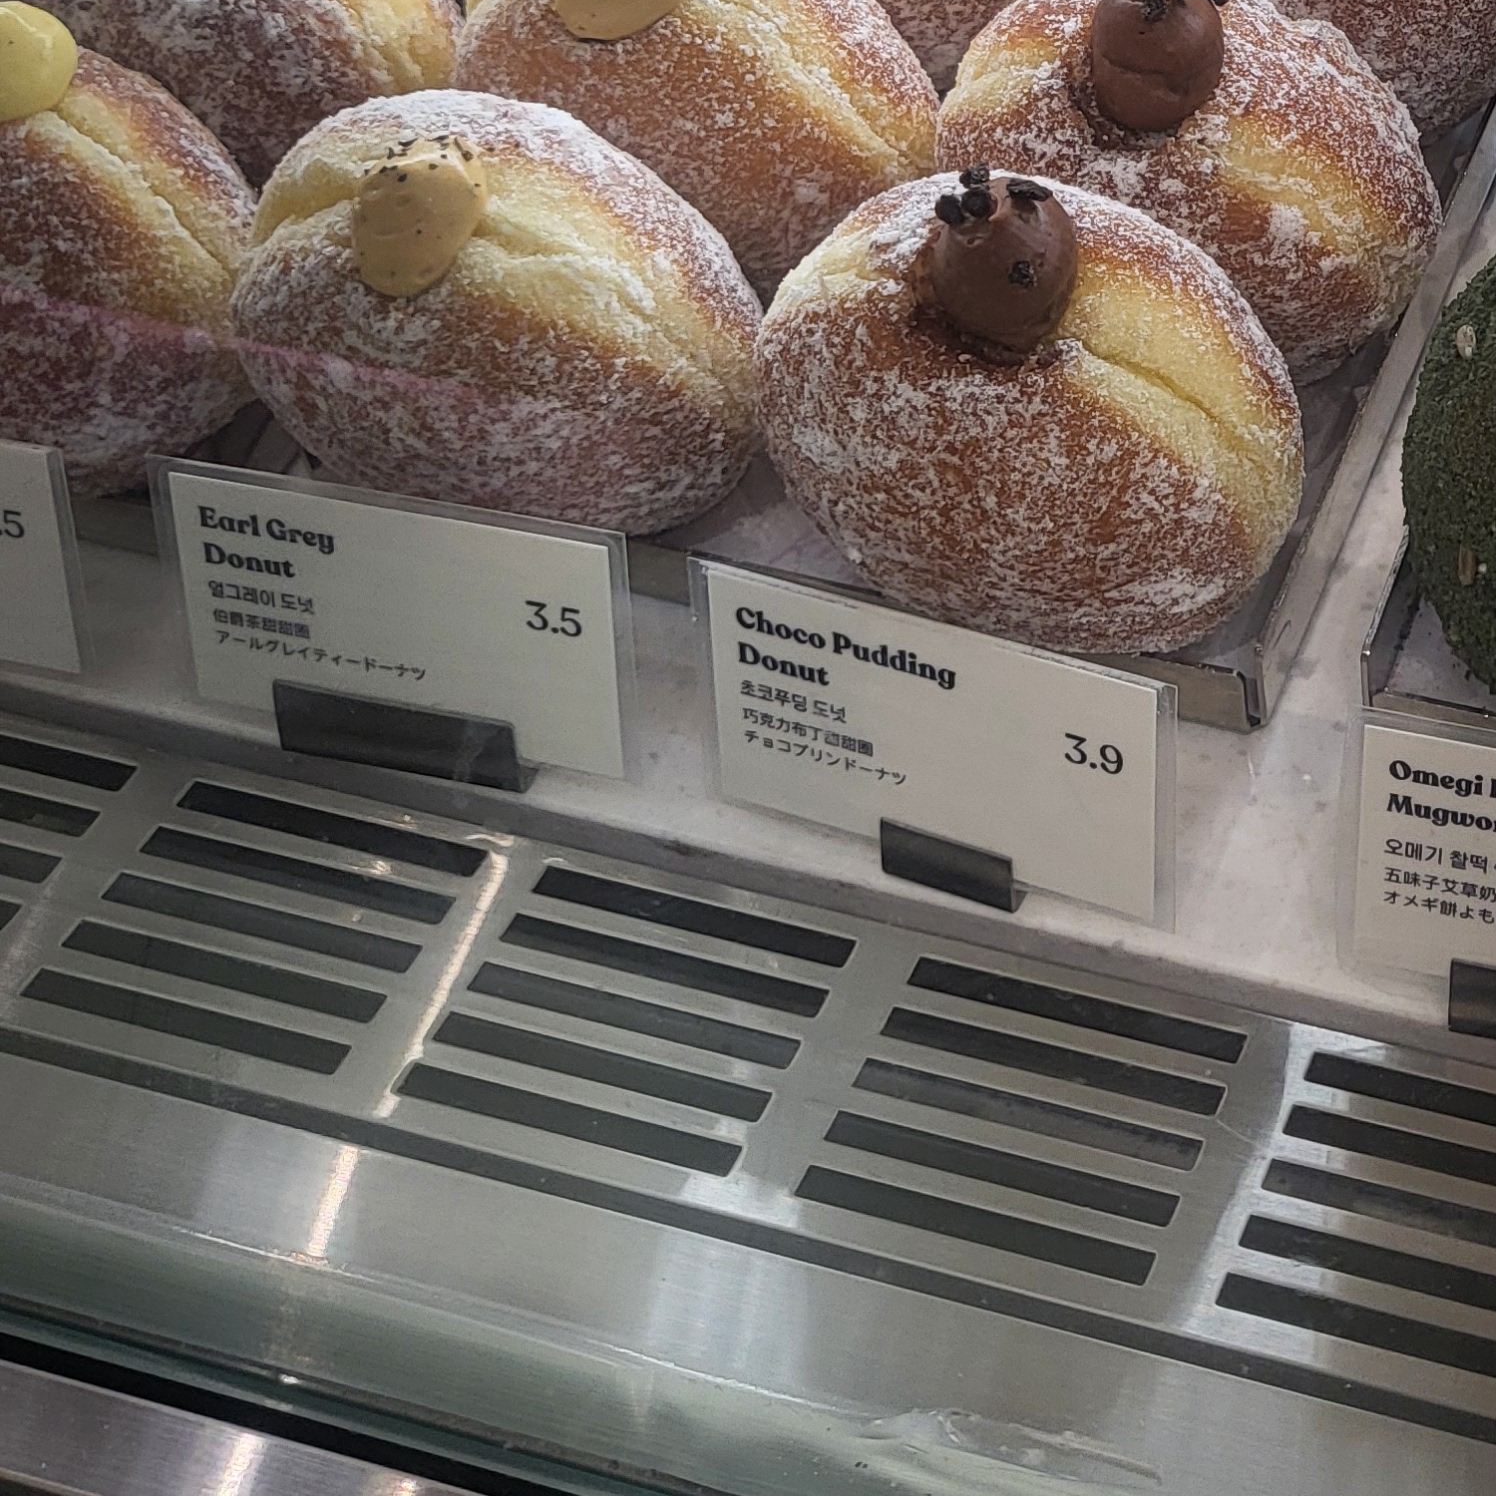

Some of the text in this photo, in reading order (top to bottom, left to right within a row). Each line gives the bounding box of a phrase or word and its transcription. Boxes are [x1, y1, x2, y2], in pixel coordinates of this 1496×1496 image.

[198, 505, 335, 555] Earl Grey
[202, 542, 296, 578] Donut
[208, 580, 315, 616] 얼그레이 도넛
[525, 600, 582, 637] 3.5
[216, 630, 426, 681] アールグレイティードーナツ
[736, 606, 957, 690] Choco Pudding
[738, 641, 830, 686] Donut
[740, 680, 847, 724] 초코푸딩 도넛
[742, 707, 874, 757] 巧克力布丁甜甜圈
[1065, 732, 1123, 775] 3.9
[744, 730, 906, 785] チョコプリンドーナツ
[1388, 760, 1483, 797] Omegi
[1384, 838, 1443, 865] 오메기
[1450, 850, 1488, 874] 찰떡
